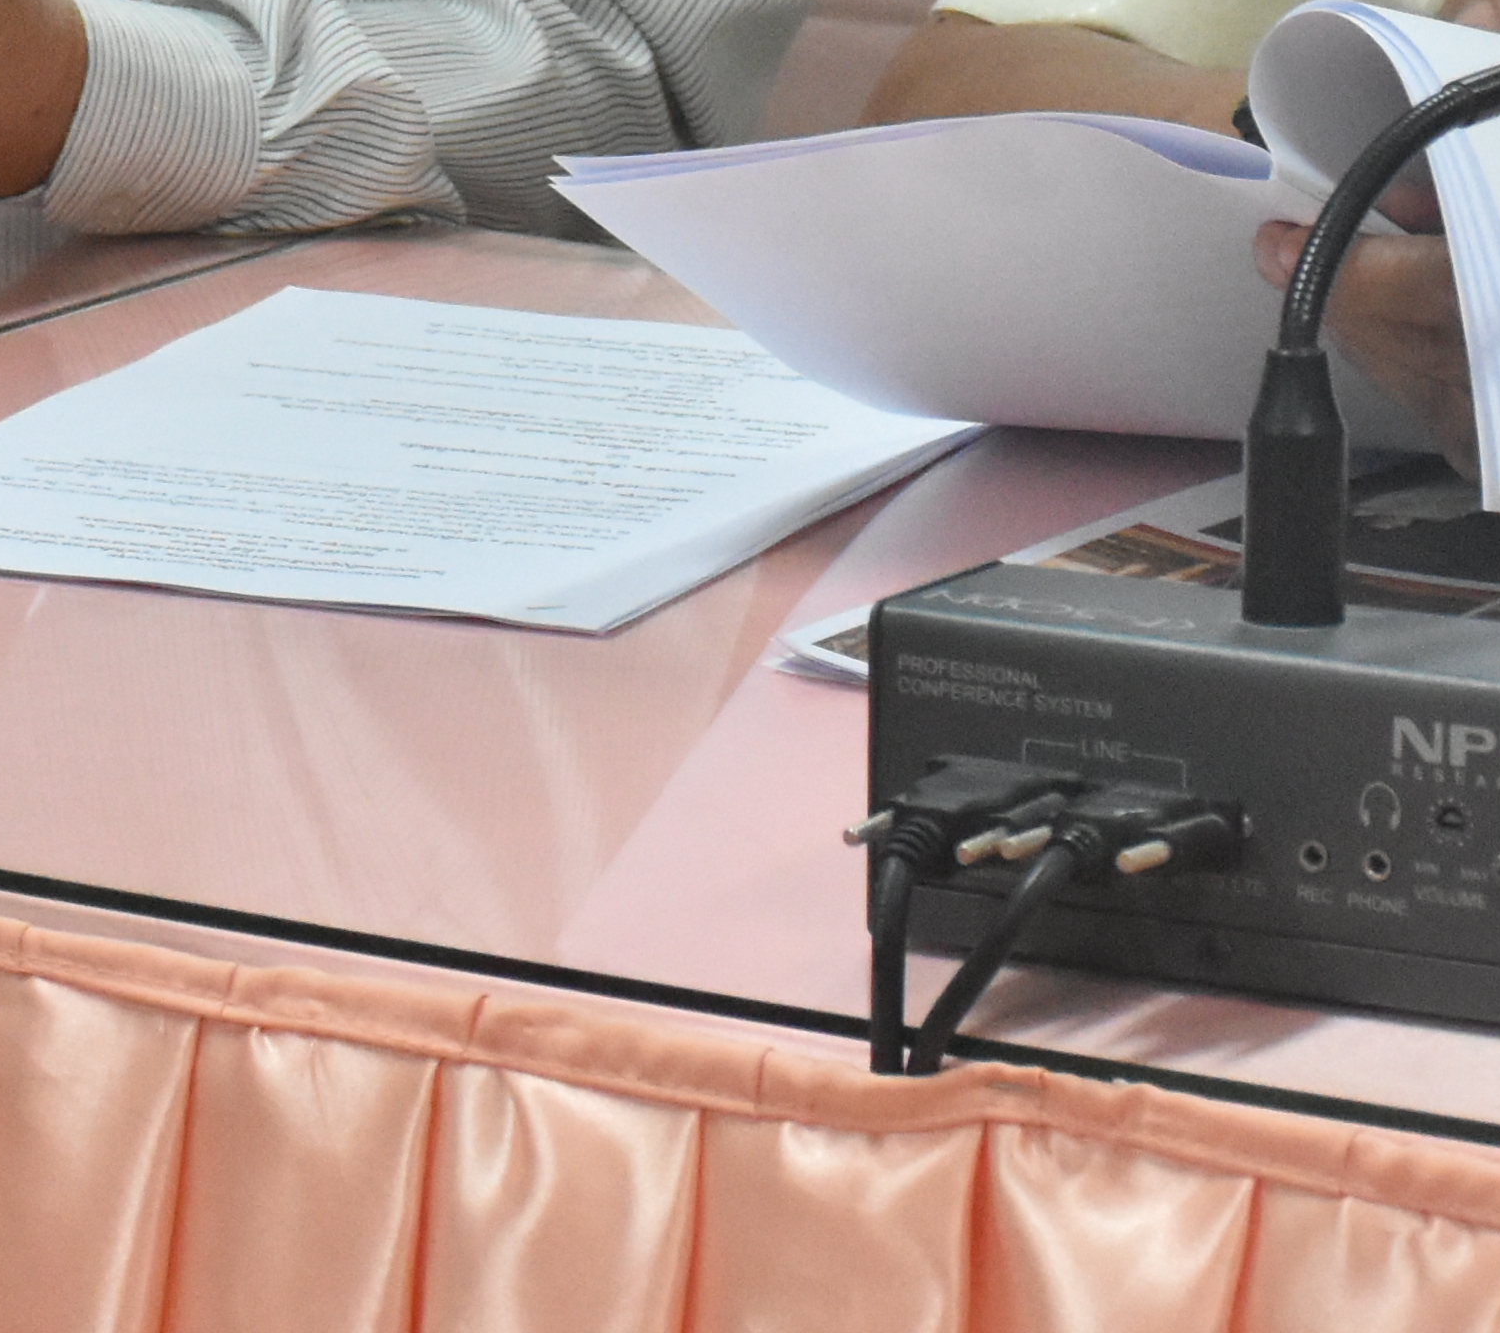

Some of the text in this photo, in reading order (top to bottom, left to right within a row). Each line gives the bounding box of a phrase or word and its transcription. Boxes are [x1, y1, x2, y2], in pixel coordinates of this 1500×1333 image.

[898, 653, 1040, 690] PROFESSIONAL
[898, 676, 1113, 720] CONFERENCE SYSTEM
[1081, 739, 1131, 763] LINE
[1346, 891, 1408, 917] PHONE
